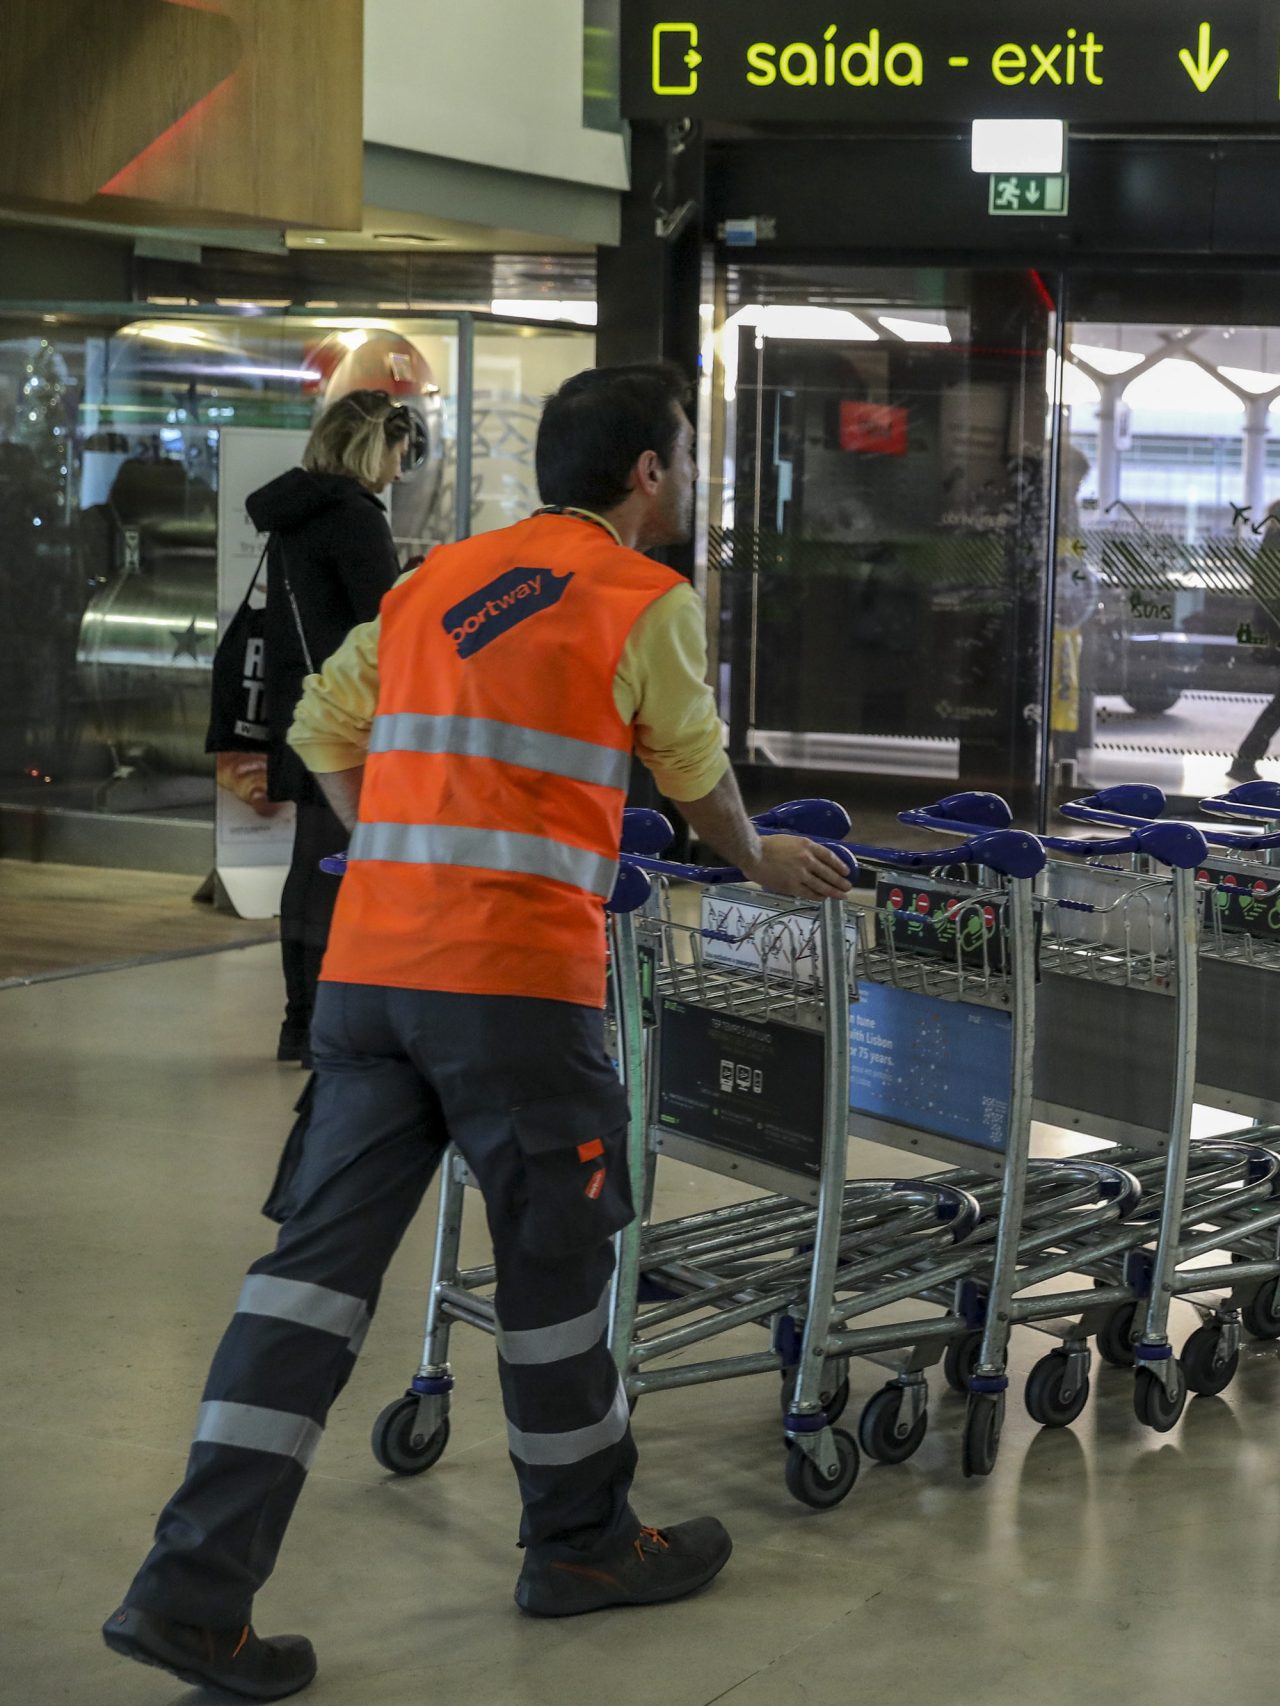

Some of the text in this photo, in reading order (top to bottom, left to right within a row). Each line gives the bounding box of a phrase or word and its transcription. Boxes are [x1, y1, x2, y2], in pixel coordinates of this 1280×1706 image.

[746, 24, 923, 87] saída
[991, 29, 1104, 86] exit
[450, 574, 542, 650] portway
[865, 1031, 894, 1050] Lisbon
